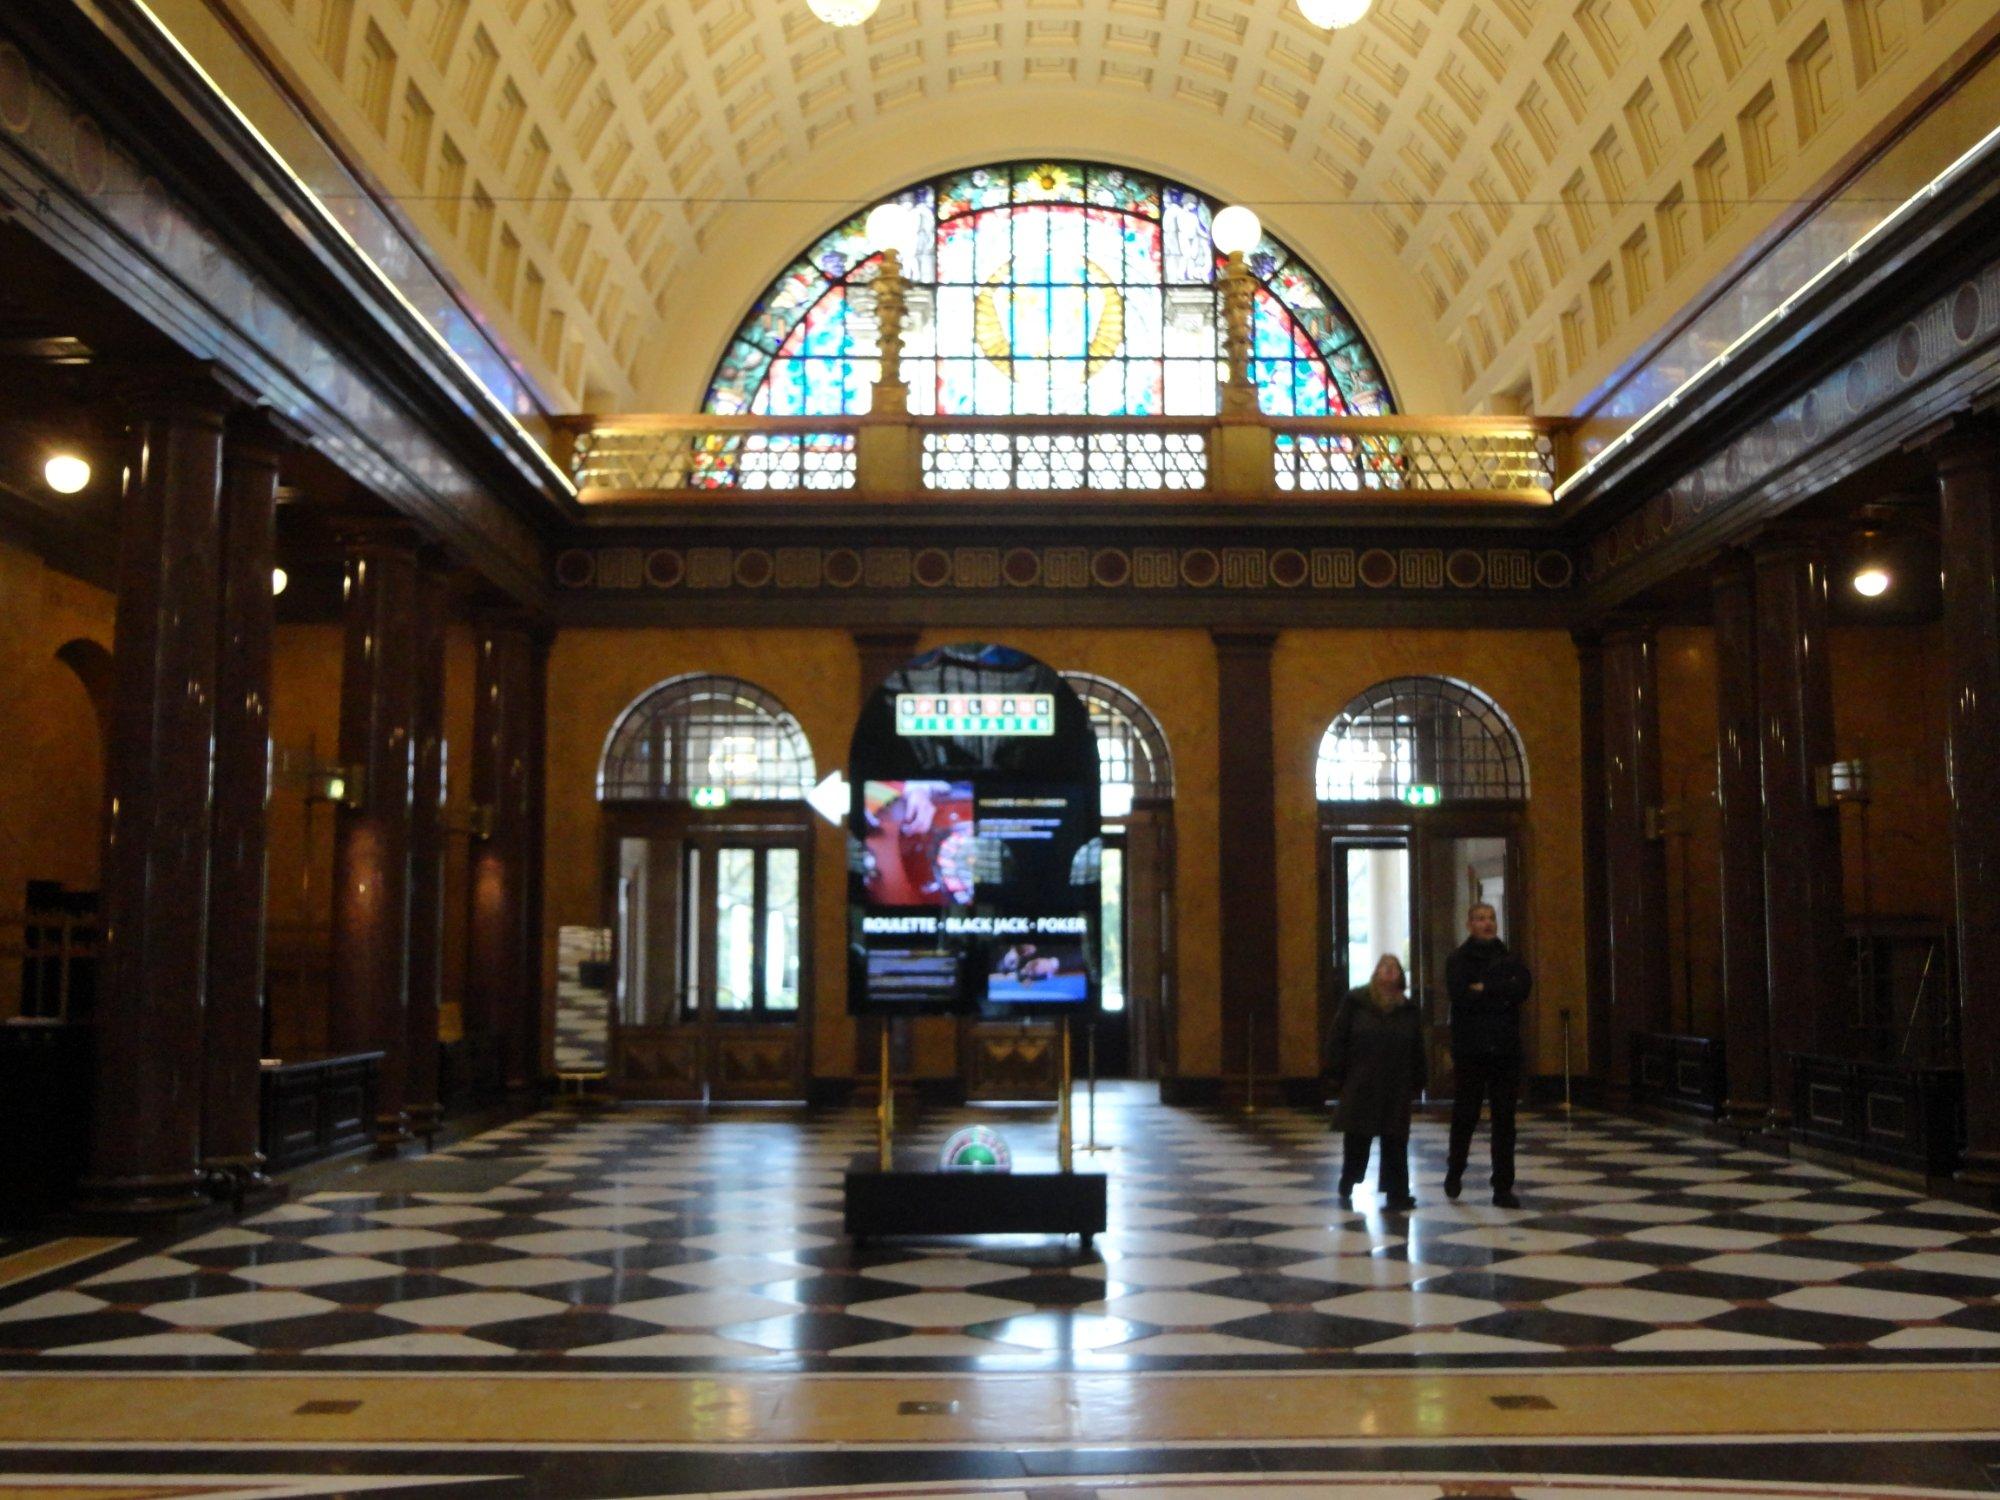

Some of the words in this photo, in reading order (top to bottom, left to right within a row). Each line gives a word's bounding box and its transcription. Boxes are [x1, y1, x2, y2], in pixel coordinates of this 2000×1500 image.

[863, 917, 936, 933] ROULETTE
[945, 917, 992, 933] BLACK
[993, 917, 1029, 935] JACK
[1037, 917, 1087, 933] POKER
